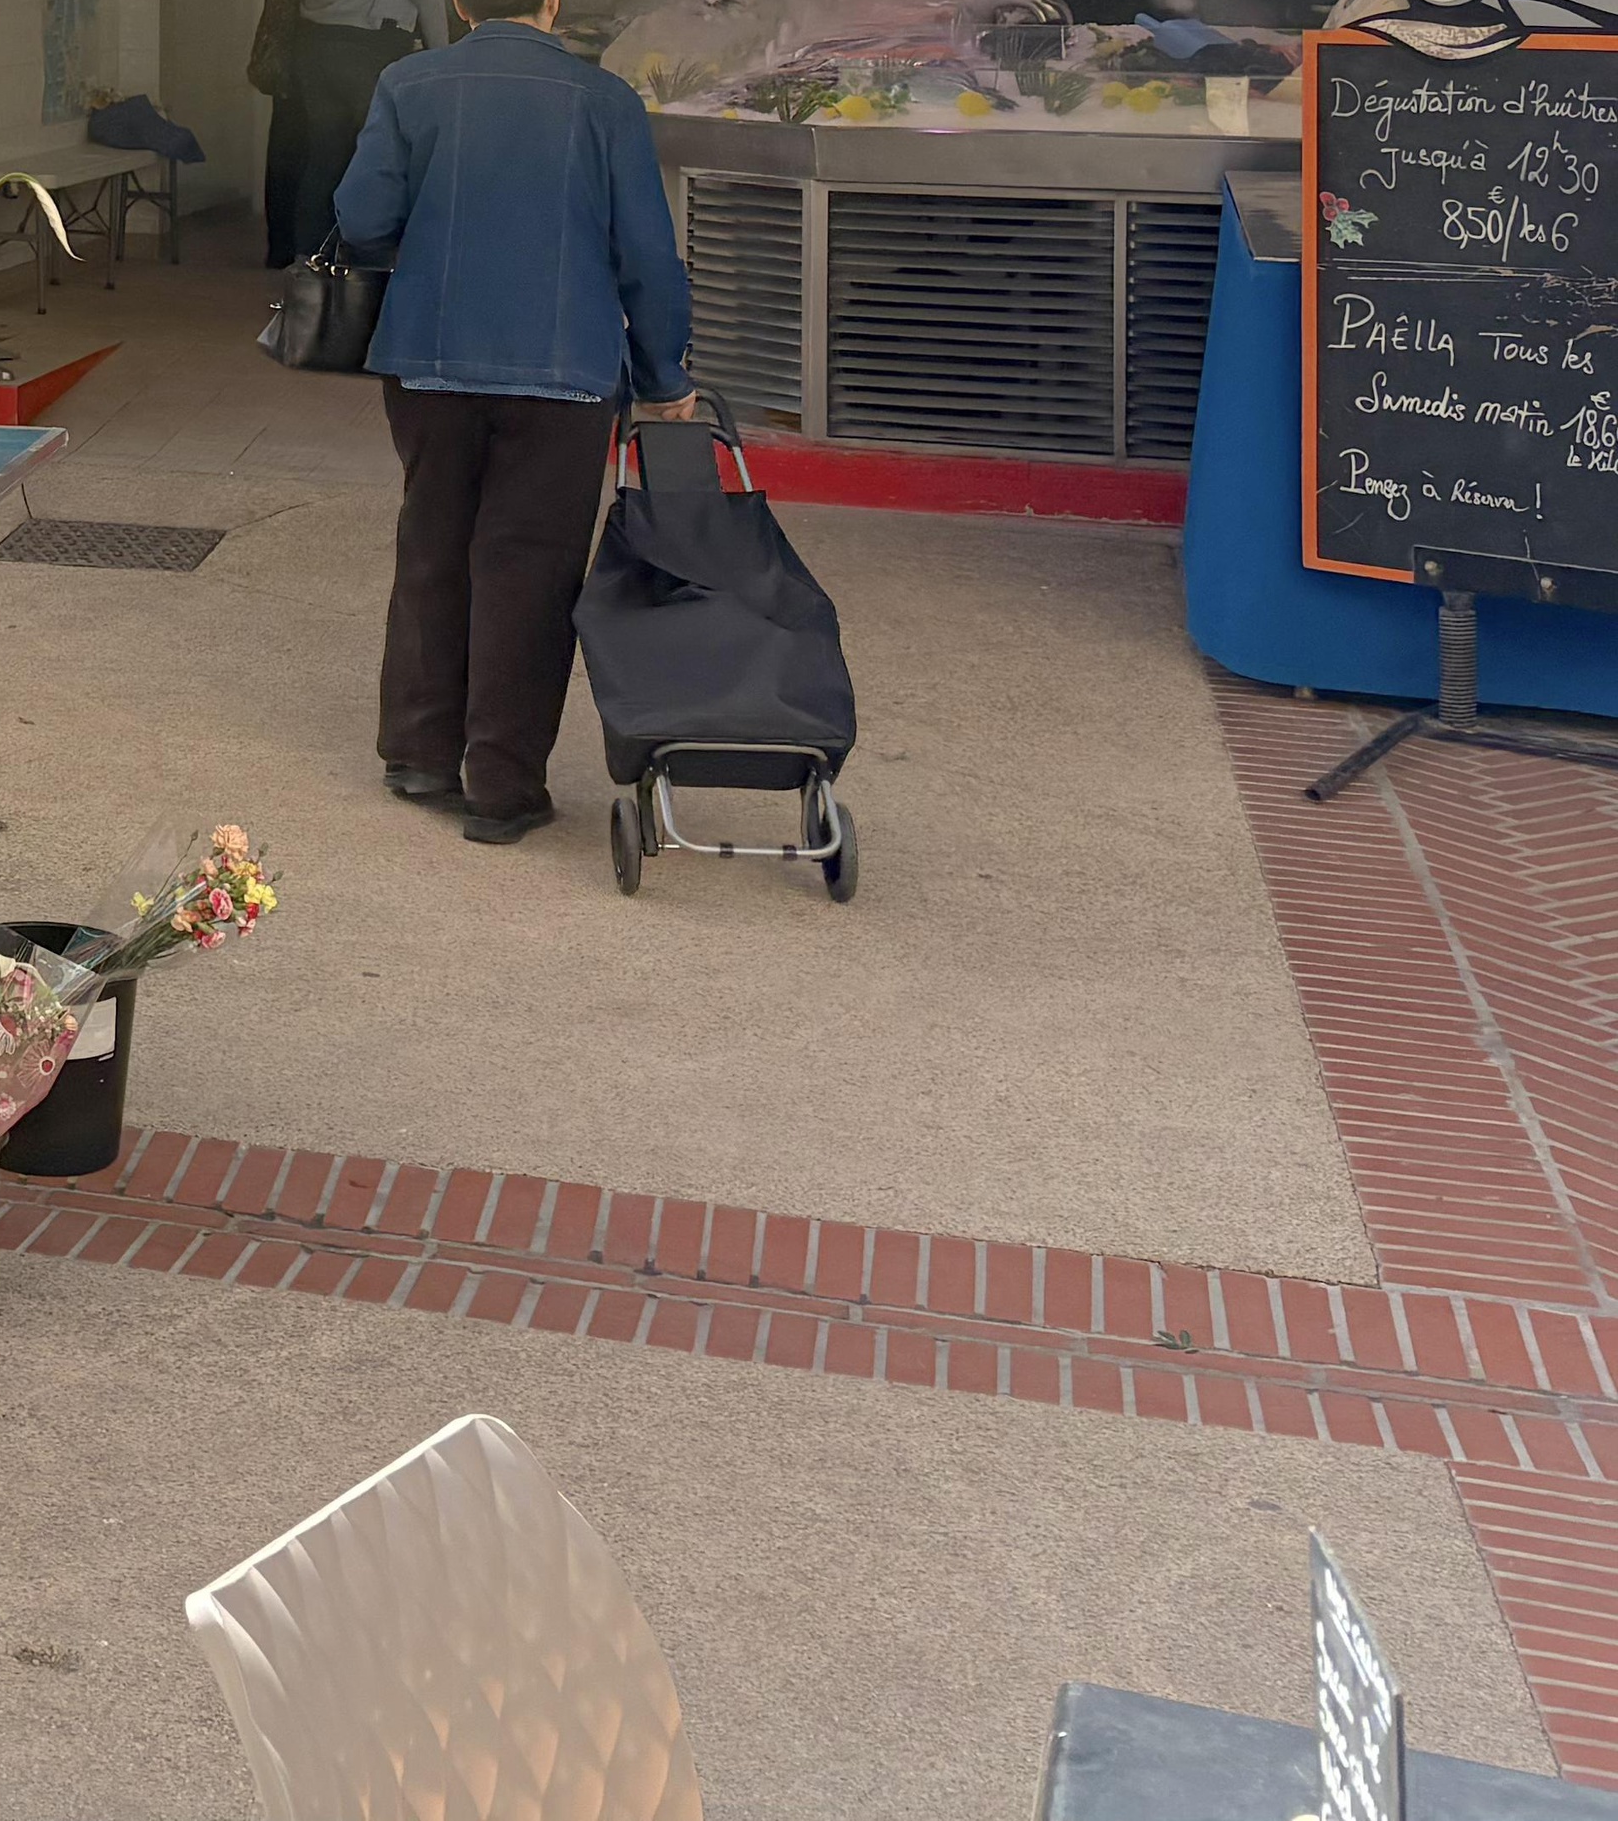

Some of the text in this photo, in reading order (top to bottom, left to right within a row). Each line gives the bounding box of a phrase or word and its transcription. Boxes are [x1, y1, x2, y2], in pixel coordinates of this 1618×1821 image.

[1331, 78, 1496, 142] Dégustation
[1479, 332, 1549, 364] Tous
[1562, 338, 1595, 374] les
[1355, 371, 1466, 422] Samedis
[1474, 400, 1555, 437] matin
[1339, 448, 1412, 521] Pensez
